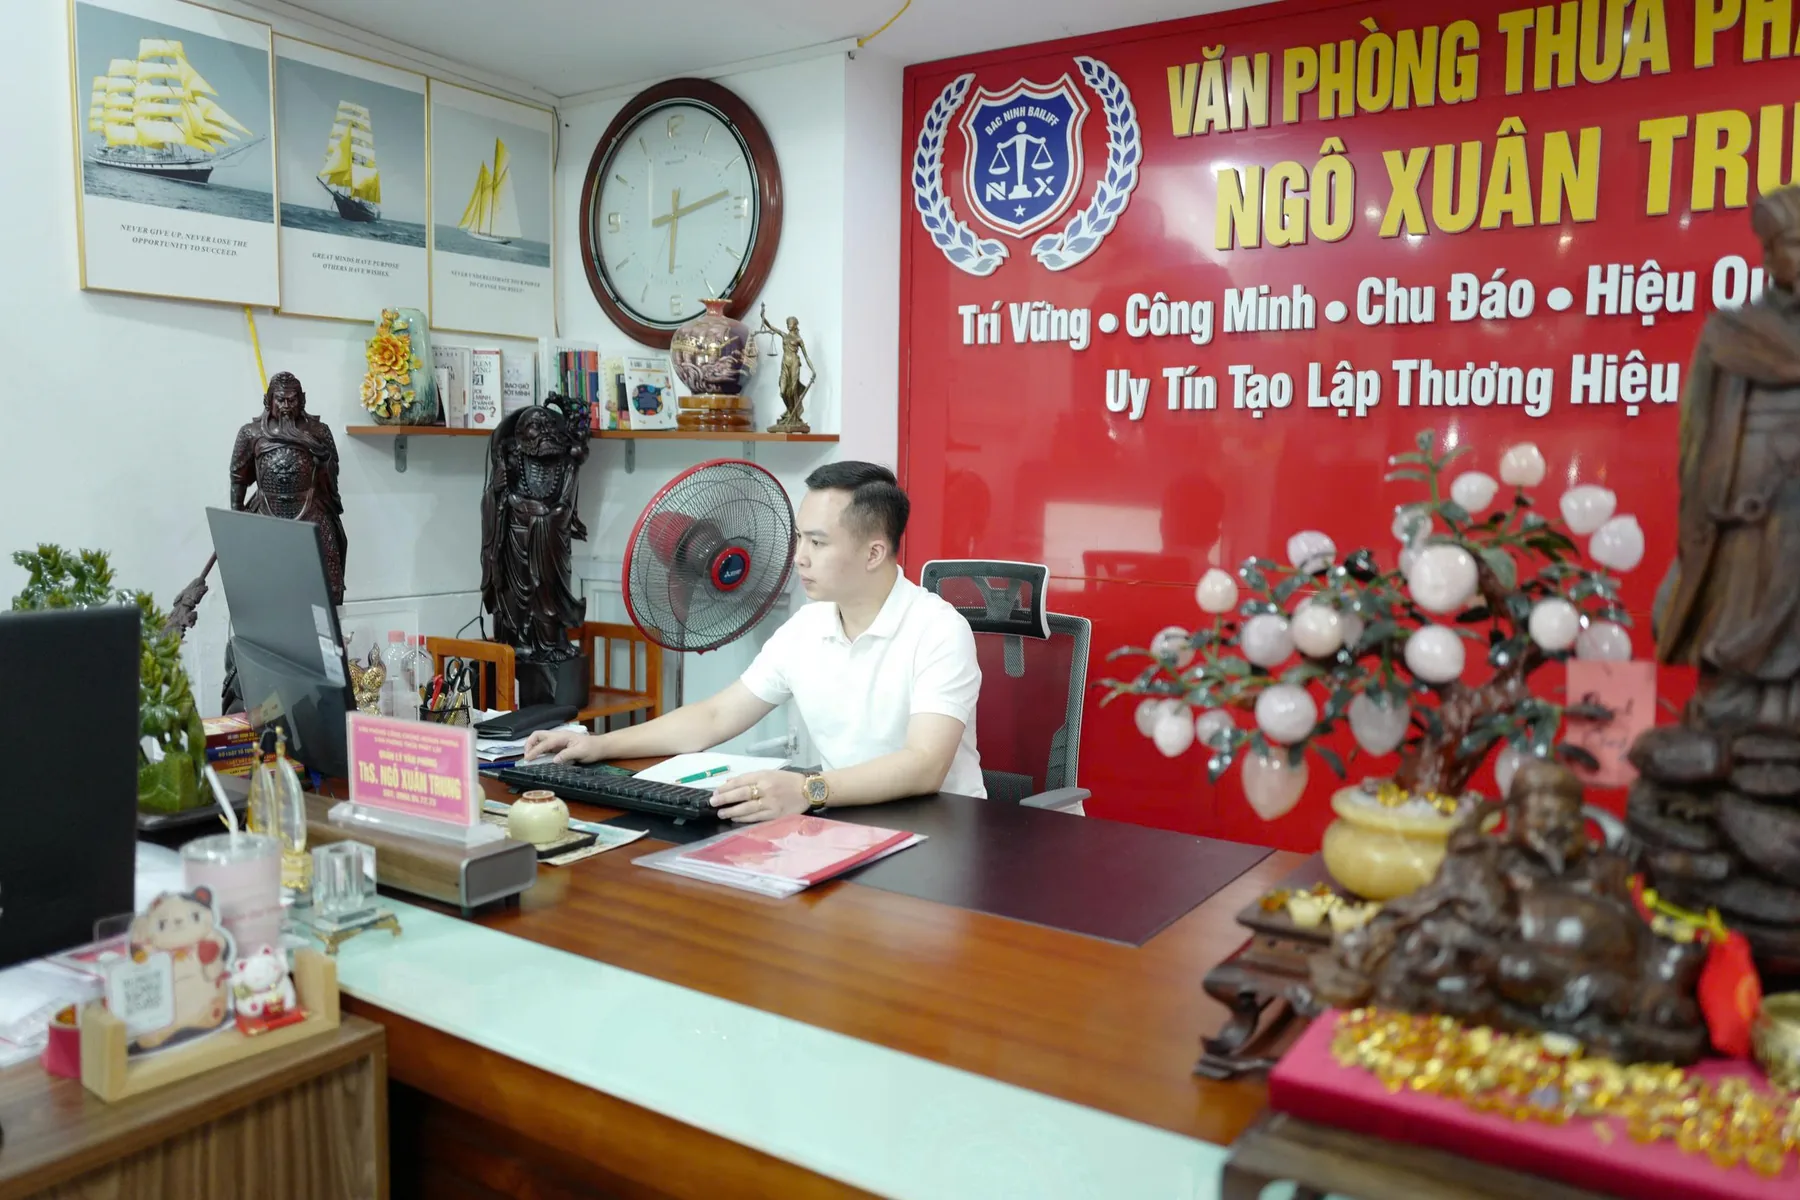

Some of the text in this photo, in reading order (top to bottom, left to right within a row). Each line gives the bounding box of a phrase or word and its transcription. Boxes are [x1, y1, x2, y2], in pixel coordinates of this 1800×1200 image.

[1167, 44, 1269, 138] VĂN
[1283, 17, 1481, 123] PHÒNG
[985, 106, 1060, 136] BAC NINH BAILIFF
[1215, 137, 1355, 250] NGÔ
[1379, 116, 1602, 238] XUÂN
[120, 224, 148, 234] NEVER
[150, 228, 169, 237] GIVE
[185, 233, 211, 243] NEVER
[212, 236, 231, 246] LOSE
[233, 240, 248, 248] THE
[132, 237, 188, 250] OPPORTUNITY
[312, 252, 399, 269] GREAT MINDS HAVE PURPOSE
[322, 263, 347, 272] OTHERS
[958, 300, 1002, 345] Trí
[1009, 299, 1091, 350] Vững
[1126, 291, 1214, 345] Công
[1223, 284, 1316, 333] Minh
[1357, 273, 1435, 326] Chu
[1447, 269, 1535, 322] Đáo
[1586, 259, 1696, 327] Hiệu
[1105, 350, 1680, 420] Uy Tín Tạo Lập Thương Hiệu
